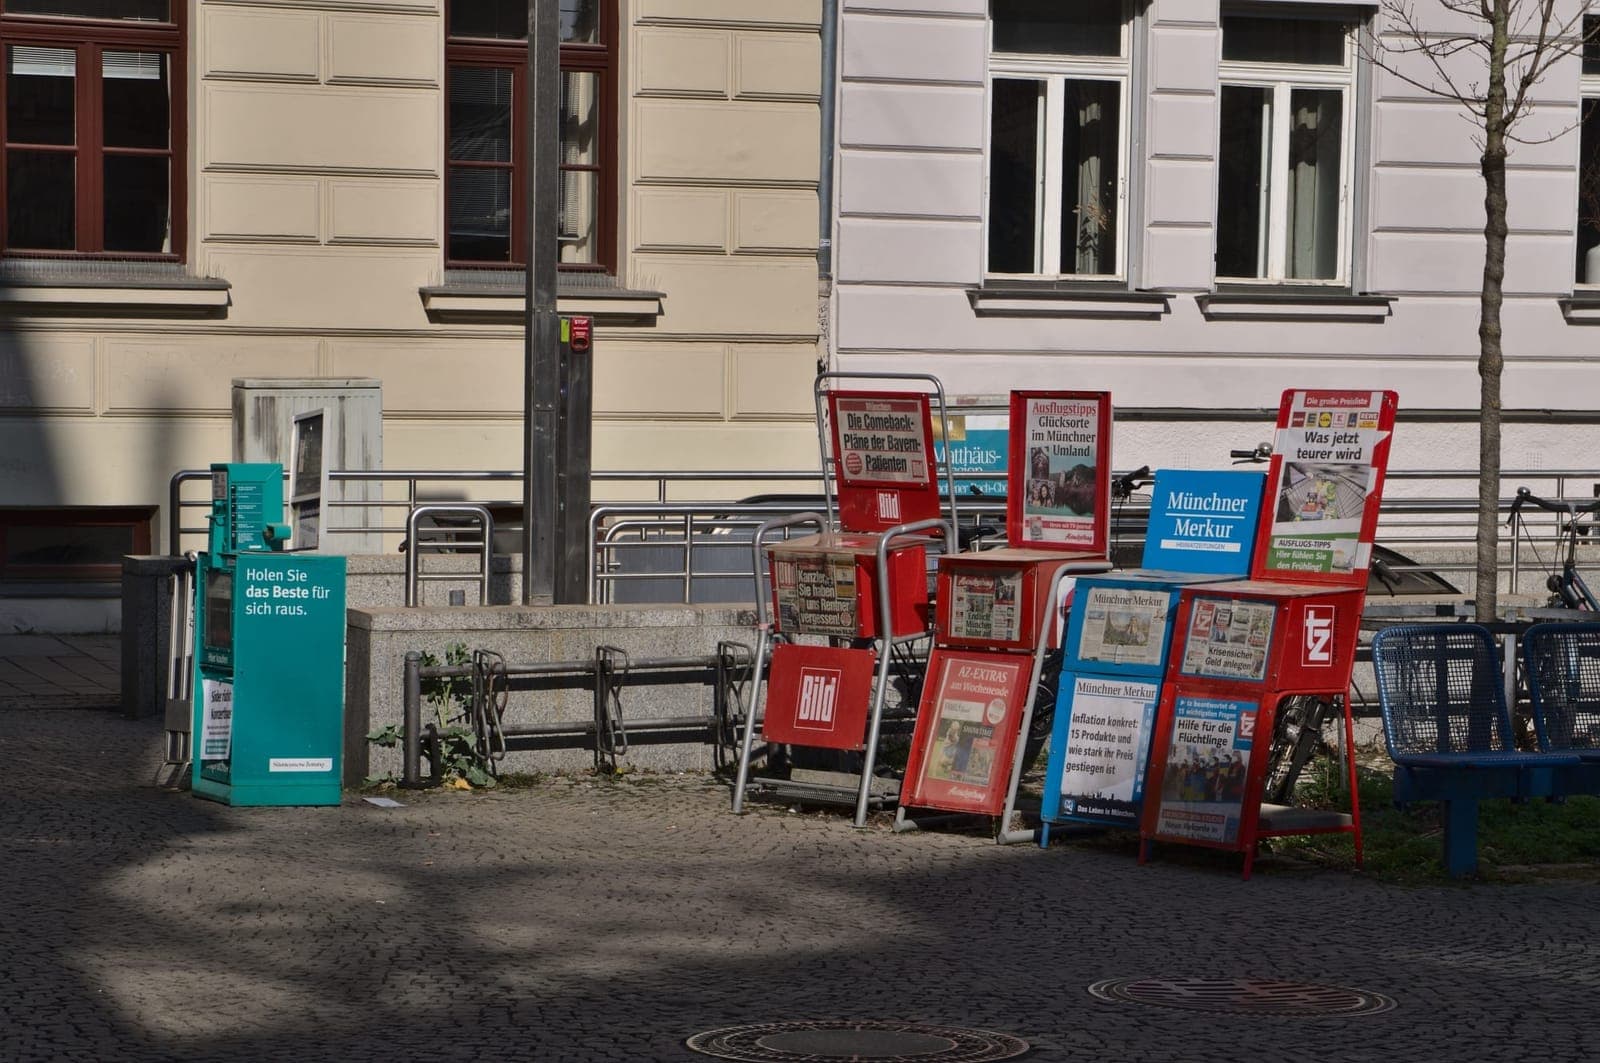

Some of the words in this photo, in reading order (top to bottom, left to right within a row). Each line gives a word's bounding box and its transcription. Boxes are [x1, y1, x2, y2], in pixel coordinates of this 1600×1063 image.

[1032, 401, 1097, 416] Ausflugstipps
[847, 413, 863, 428] Die
[864, 414, 915, 431] Comeback-
[1038, 416, 1090, 429] Glücksorte
[844, 433, 870, 449] Pläne
[870, 434, 886, 450] der
[887, 434, 921, 452] Bayern-
[1031, 431, 1044, 442] im
[1046, 430, 1096, 443] Münchner
[1304, 431, 1330, 444] Was
[1330, 431, 1360, 447] jetzt
[1052, 444, 1090, 457] Umland
[1296, 447, 1333, 460] teurer
[1335, 447, 1362, 460] wird
[865, 454, 907, 472] Patienten
[878, 492, 900, 520] Bild
[1167, 491, 1248, 512] Münchner
[1173, 518, 1234, 538] Merkur
[1275, 550, 1291, 559] Hier
[1292, 550, 1314, 560] fühlen
[1315, 552, 1327, 560] Sie
[1276, 561, 1290, 570] den
[246, 568, 284, 582] Holen
[287, 569, 308, 582] Sie
[245, 584, 270, 598] das
[272, 585, 310, 599] Beste
[312, 585, 331, 599] für
[799, 583, 812, 597] Sie
[812, 584, 835, 598] haben
[806, 599, 821, 610] uns
[821, 599, 850, 612] Rentner
[1093, 593, 1132, 606] Münchner
[1132, 595, 1162, 607] Merkur
[245, 602, 272, 615] sich
[275, 605, 308, 616] raus.
[800, 613, 841, 626] vergessen!
[1304, 610, 1331, 661] tz
[1208, 646, 1253, 659] Krisensicher
[1205, 657, 1222, 666] Geld
[958, 665, 1008, 683] AZ-EXTRAS
[962, 681, 1009, 697] Wochenende
[1077, 681, 1122, 695] Münchner
[1123, 685, 1156, 698] Merkur
[798, 675, 837, 722] Bild
[1072, 711, 1106, 726] Inflation
[1107, 716, 1139, 729] konkret:
[1178, 719, 1200, 731] Hilfe
[1201, 721, 1217, 732] für
[1218, 722, 1232, 734] die
[1240, 712, 1256, 737] tz
[1070, 729, 1080, 740] 15
[1081, 730, 1117, 743] Produkte
[1117, 733, 1132, 744] und
[1178, 732, 1229, 749] Flüchtlinge
[1068, 744, 1083, 755] wie
[1083, 746, 1103, 757] stark
[1103, 747, 1115, 759] ihr
[1115, 749, 1134, 760] Preis
[1065, 761, 1105, 776] gestiegen
[1105, 763, 1116, 775] ist
[1077, 804, 1088, 813] Das
[1088, 806, 1105, 815] Leben
